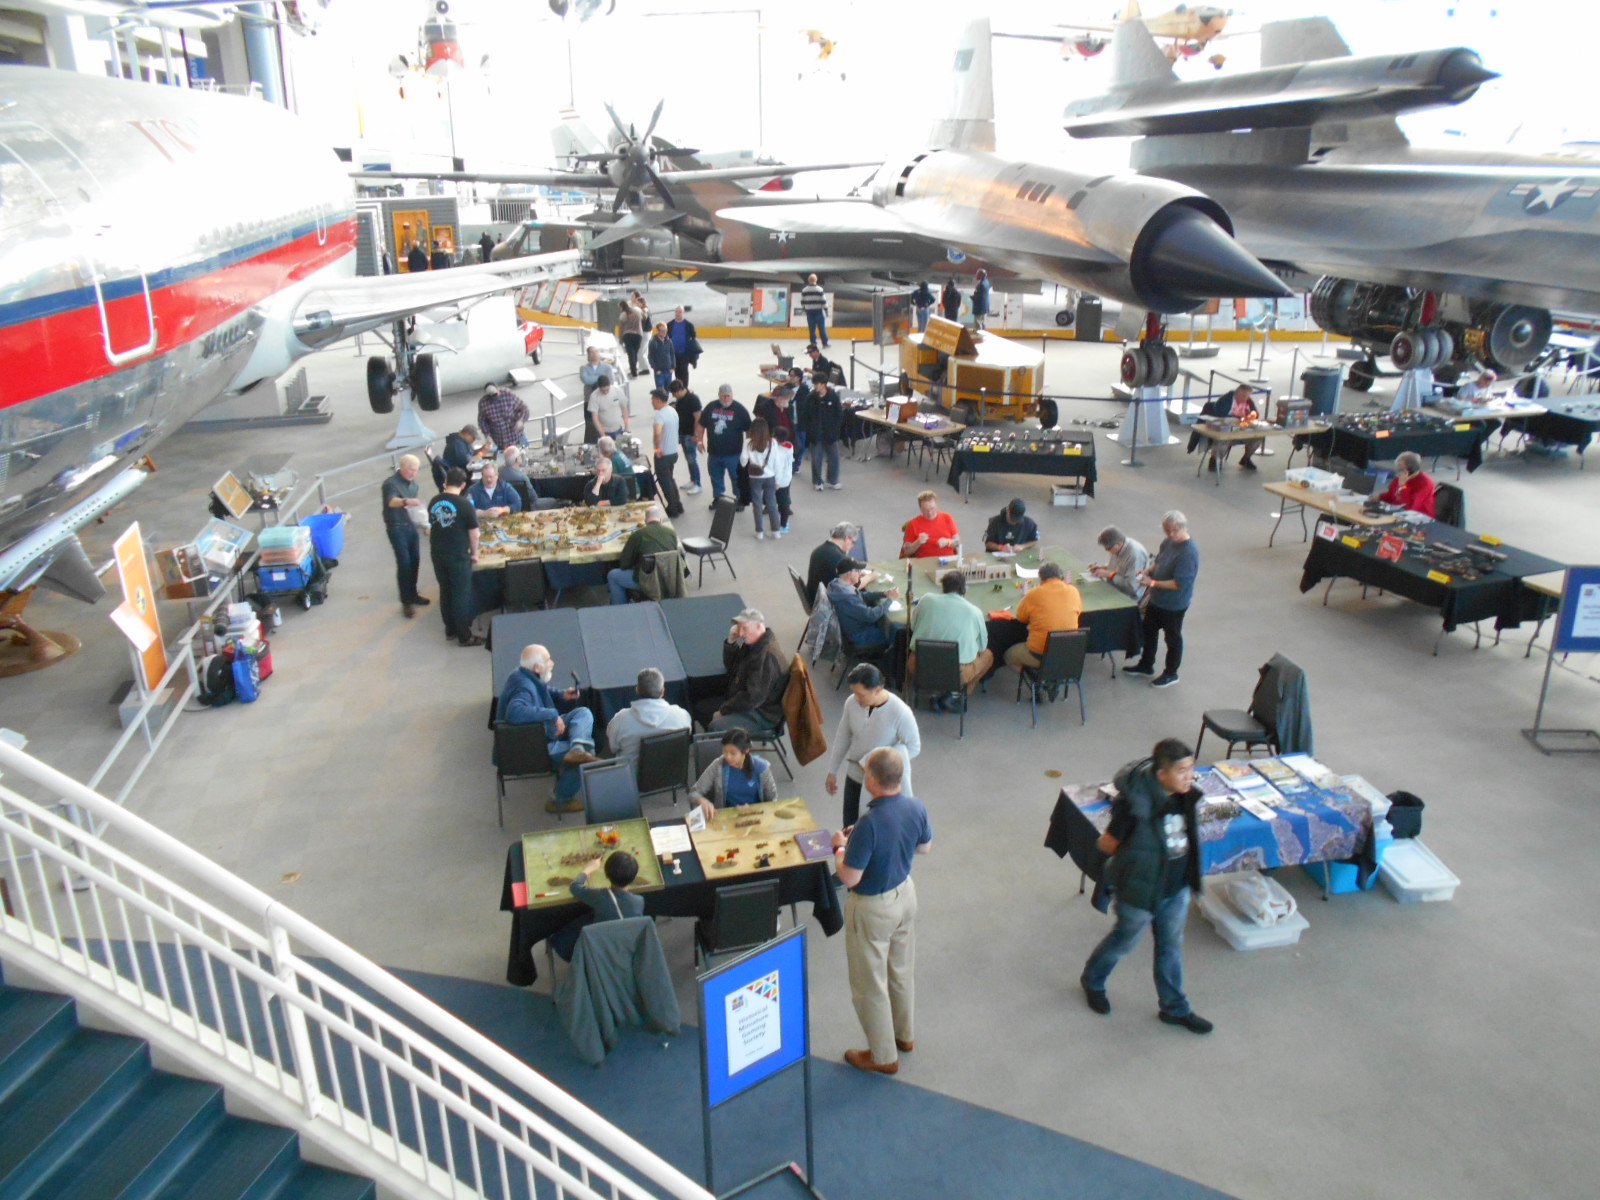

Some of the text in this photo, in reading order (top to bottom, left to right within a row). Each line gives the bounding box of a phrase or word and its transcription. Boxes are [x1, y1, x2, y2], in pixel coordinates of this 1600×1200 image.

[738, 1004, 768, 1024] Historical
[742, 1022, 766, 1039] Gaming
[743, 1031, 766, 1046] Society
